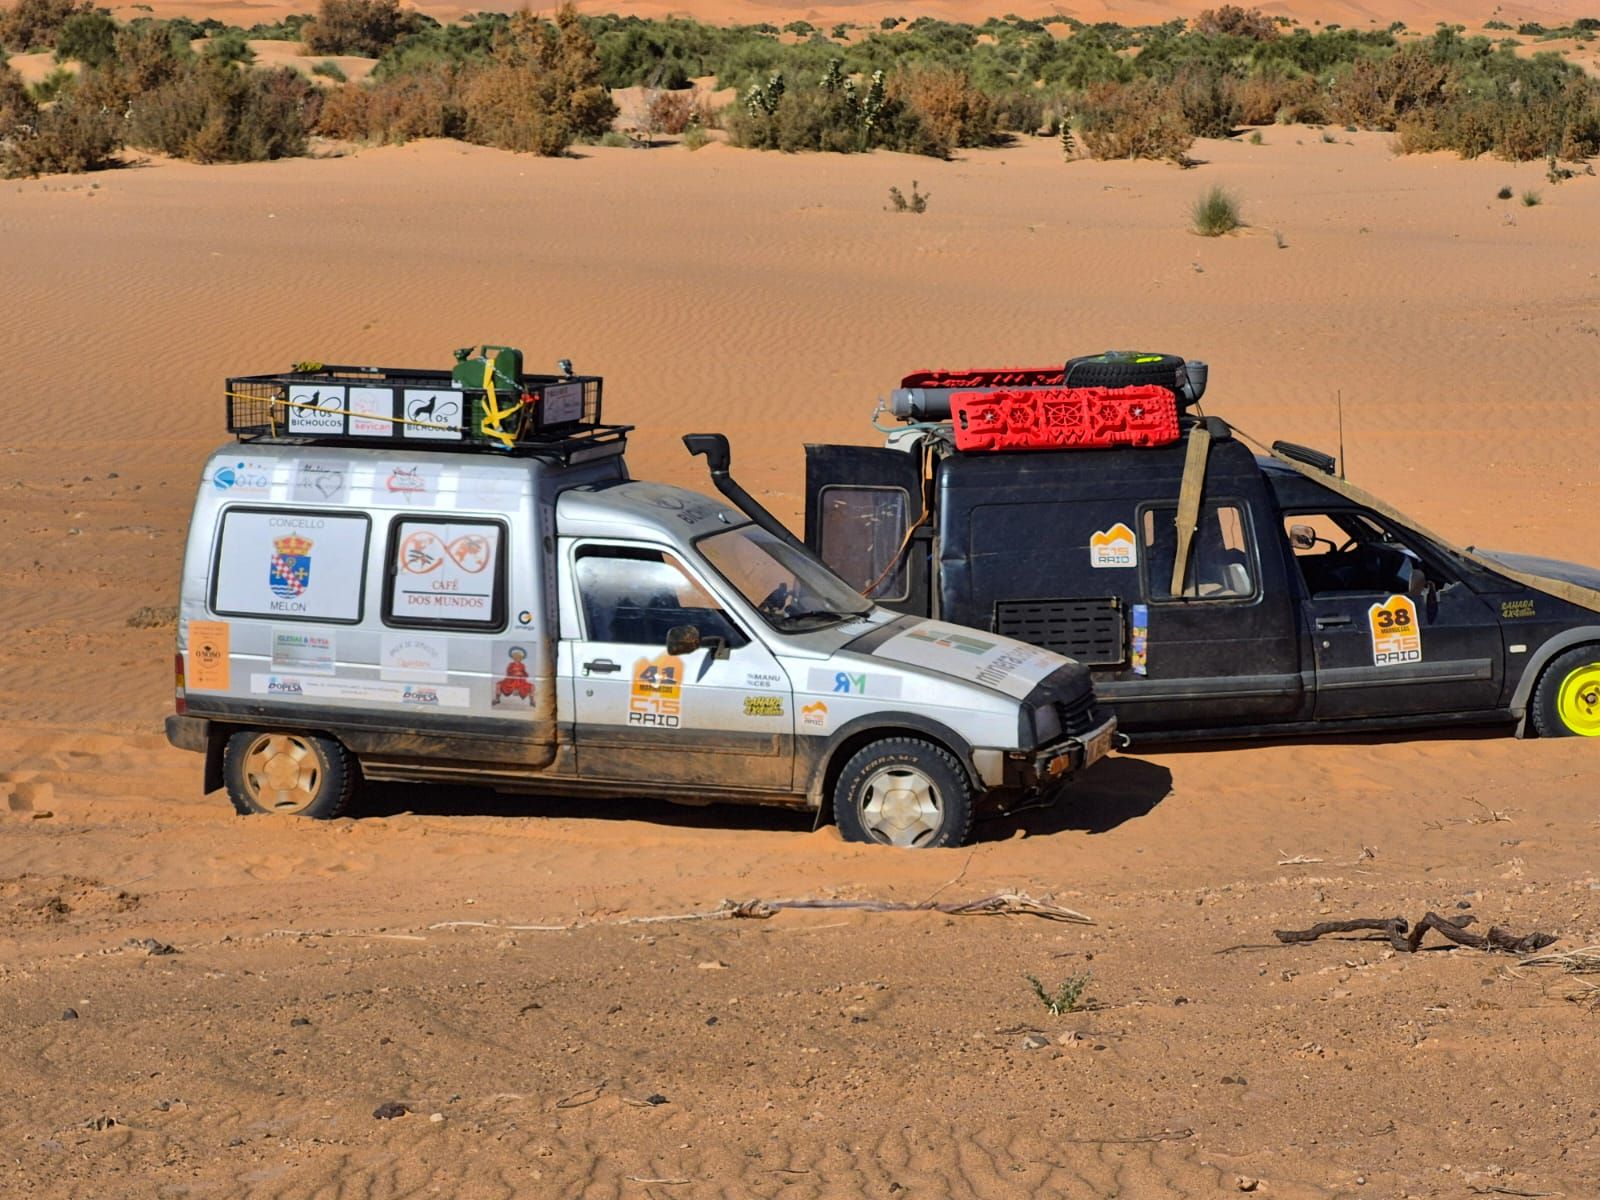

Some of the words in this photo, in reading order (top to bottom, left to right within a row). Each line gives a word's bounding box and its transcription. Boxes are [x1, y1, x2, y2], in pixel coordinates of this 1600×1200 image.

[291, 418, 343, 428] BICHOUCOS
[435, 414, 449, 423] Os
[268, 517, 325, 530] CONCELLO
[1098, 547, 1129, 556] C15
[1098, 556, 1130, 564] RAID
[431, 579, 459, 591] CAFÉ
[270, 600, 307, 612] MELON
[407, 595, 436, 606] DOS
[437, 596, 484, 608] MUNDOS
[1377, 608, 1411, 628] 38
[1375, 637, 1420, 654] C15
[1376, 650, 1420, 664] RAID
[640, 666, 677, 685] 41
[754, 674, 781, 682] MANU
[630, 697, 680, 715] C15
[629, 712, 679, 727] RAID
